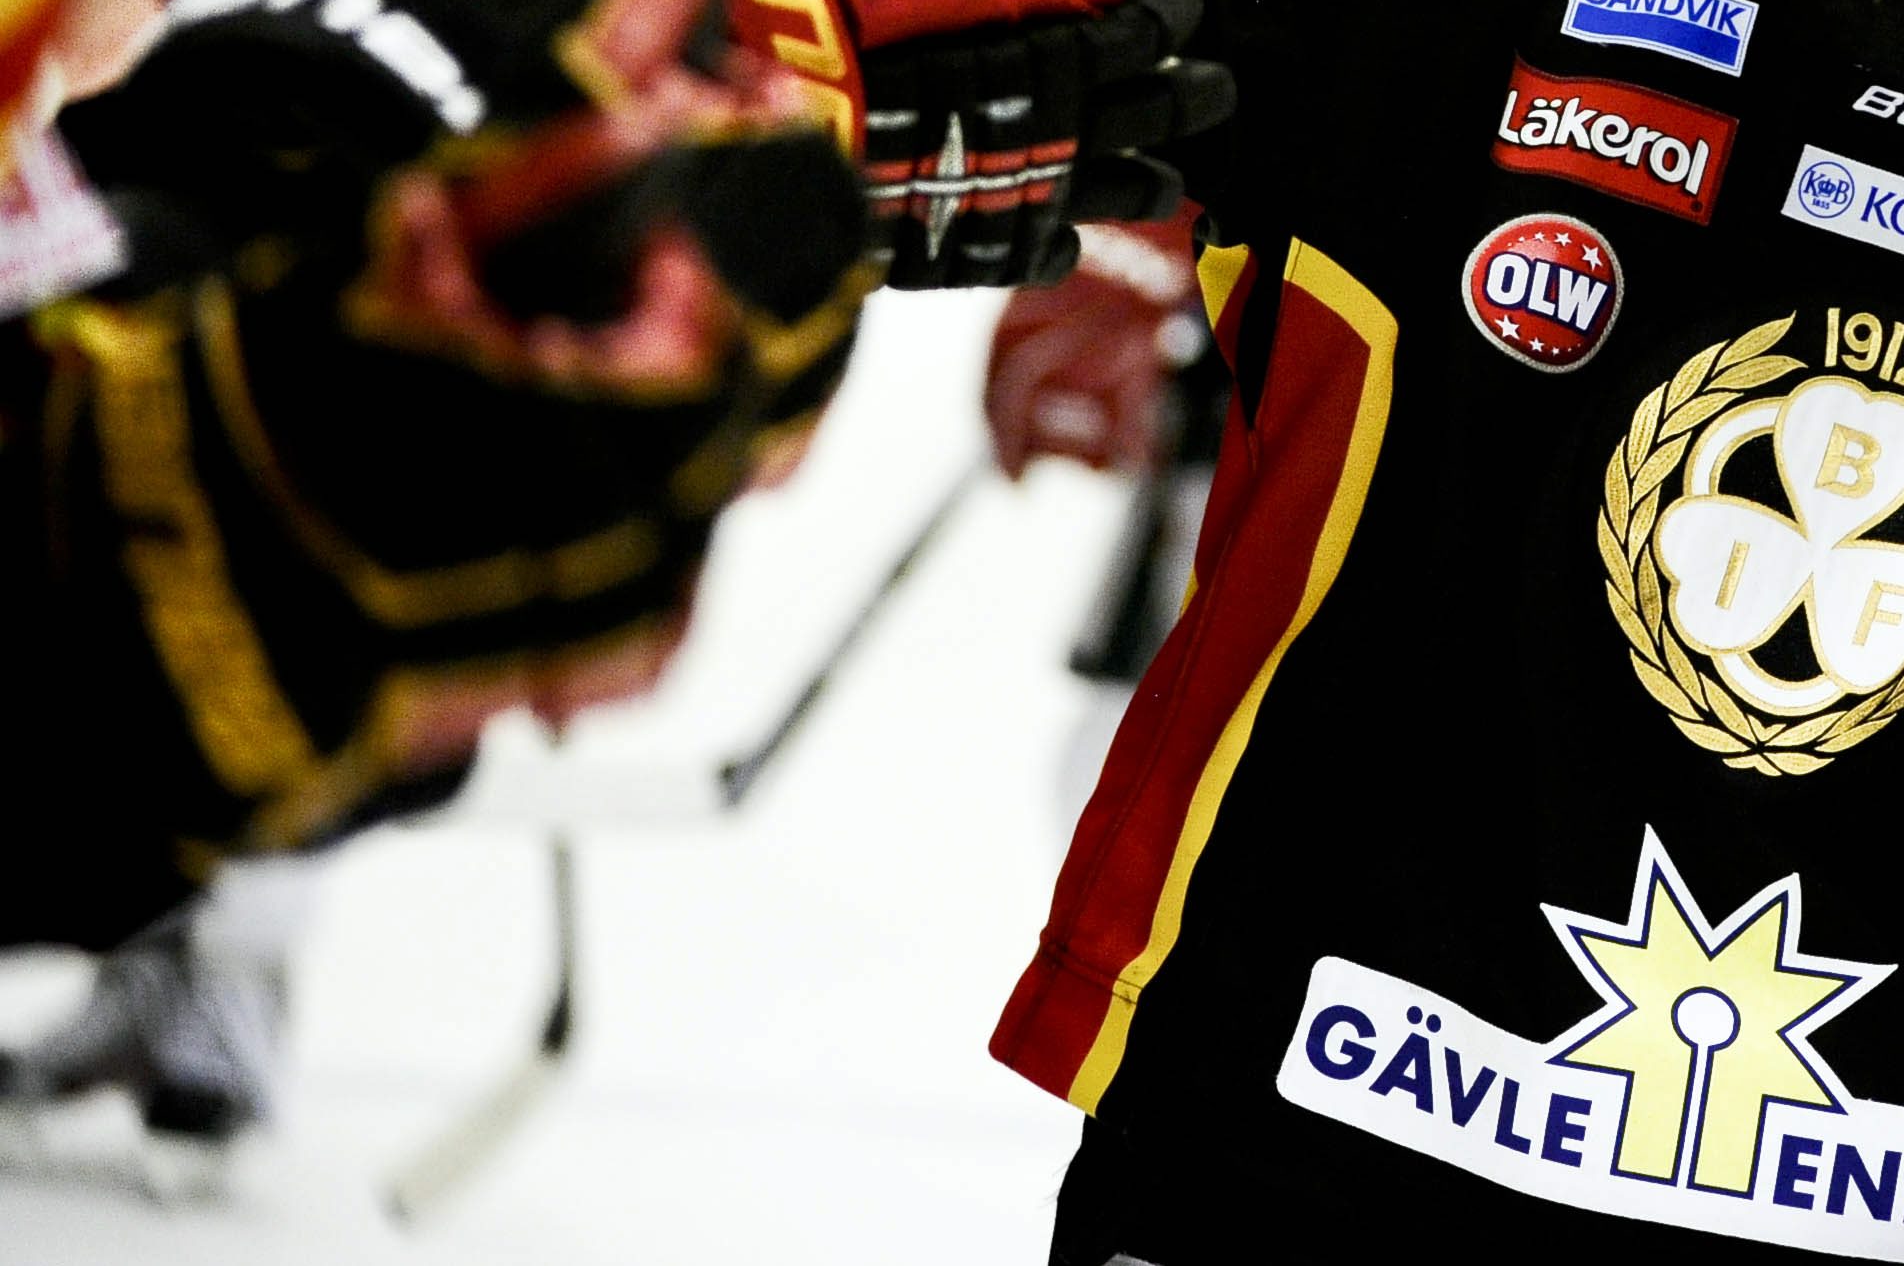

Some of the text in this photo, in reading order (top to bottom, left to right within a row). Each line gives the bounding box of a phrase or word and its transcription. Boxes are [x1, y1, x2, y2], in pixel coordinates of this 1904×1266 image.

[1497, 89, 1710, 196] Läkerol
[1485, 252, 1608, 332] OLW
[1813, 422, 1882, 499] B
[1304, 1003, 1595, 1168] GÄVLE
